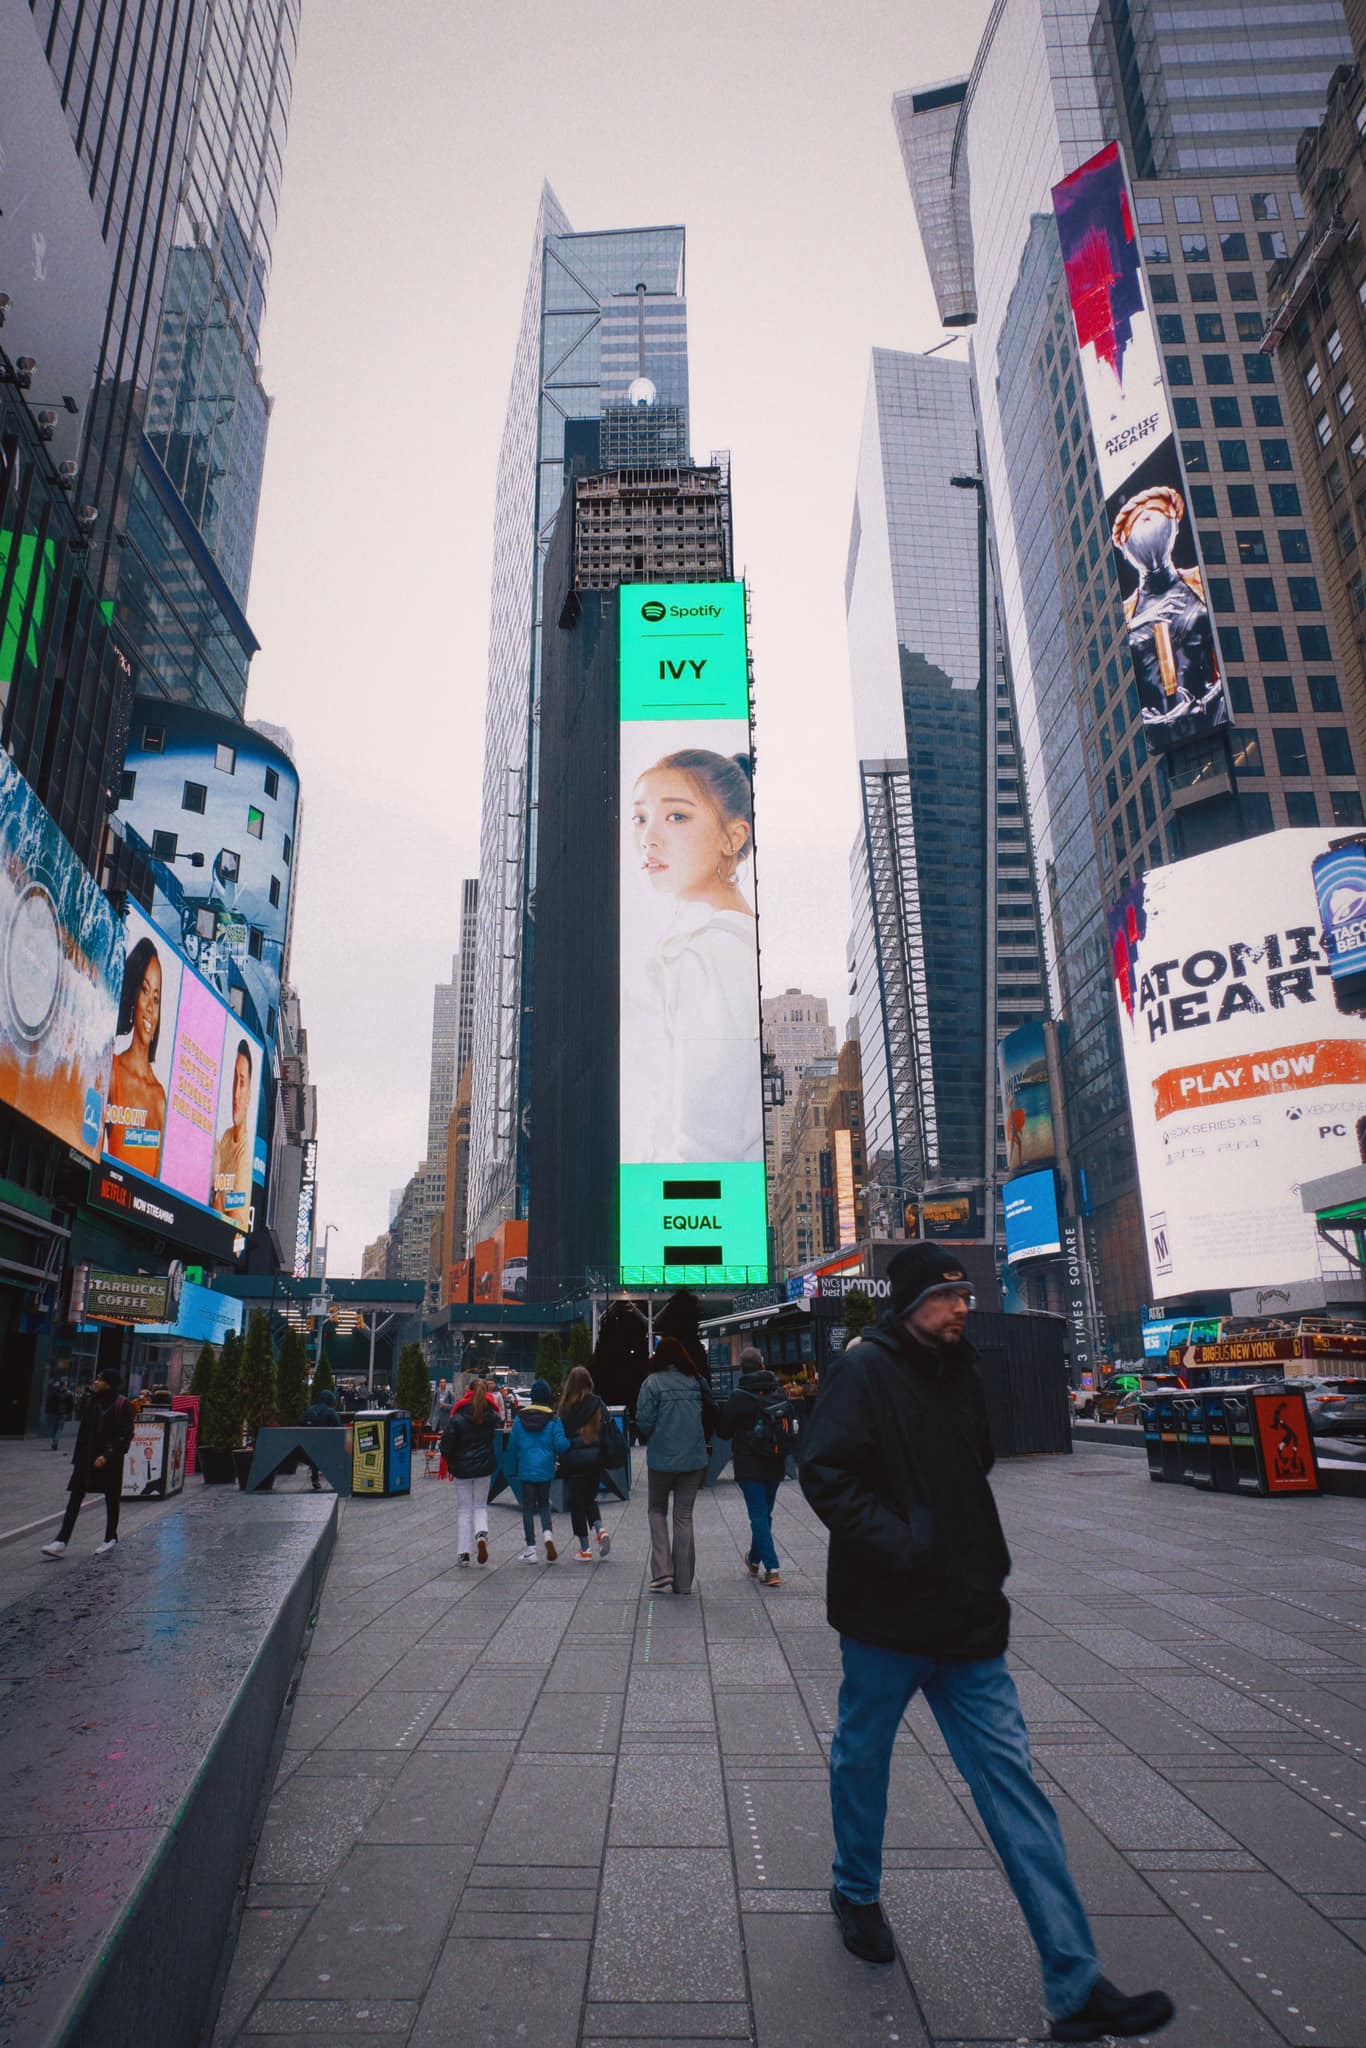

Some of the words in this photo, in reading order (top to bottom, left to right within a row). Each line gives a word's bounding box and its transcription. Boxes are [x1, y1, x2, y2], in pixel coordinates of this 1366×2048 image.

[1105, 412, 1160, 450] ATOMIC
[1108, 422, 1159, 456] HEART
[670, 604, 722, 618] Spotify
[659, 659, 707, 680] IVY
[1140, 926, 1328, 1012] ATOMI
[1179, 1067, 1243, 1097] PLAY
[1251, 1054, 1316, 1084] NOW
[1192, 1116, 1236, 1134] SERIES
[1318, 1123, 1347, 1140] PC
[303, 1142, 317, 1182] Locker
[100, 1179, 128, 1207] NETFLIX
[146, 1203, 175, 1225] STREAMING
[663, 1215, 722, 1230] EQUAL
[1064, 1227, 1080, 1286] SQUARE
[88, 1278, 166, 1297] STARBUCKS
[822, 1288, 841, 1297] best
[97, 1294, 148, 1308] COFFEE
[1072, 1300, 1086, 1345] TIMES
[1077, 1354, 1088, 1362] 3
[1230, 1342, 1250, 1360] NEW
[1251, 1340, 1276, 1359] YORK
